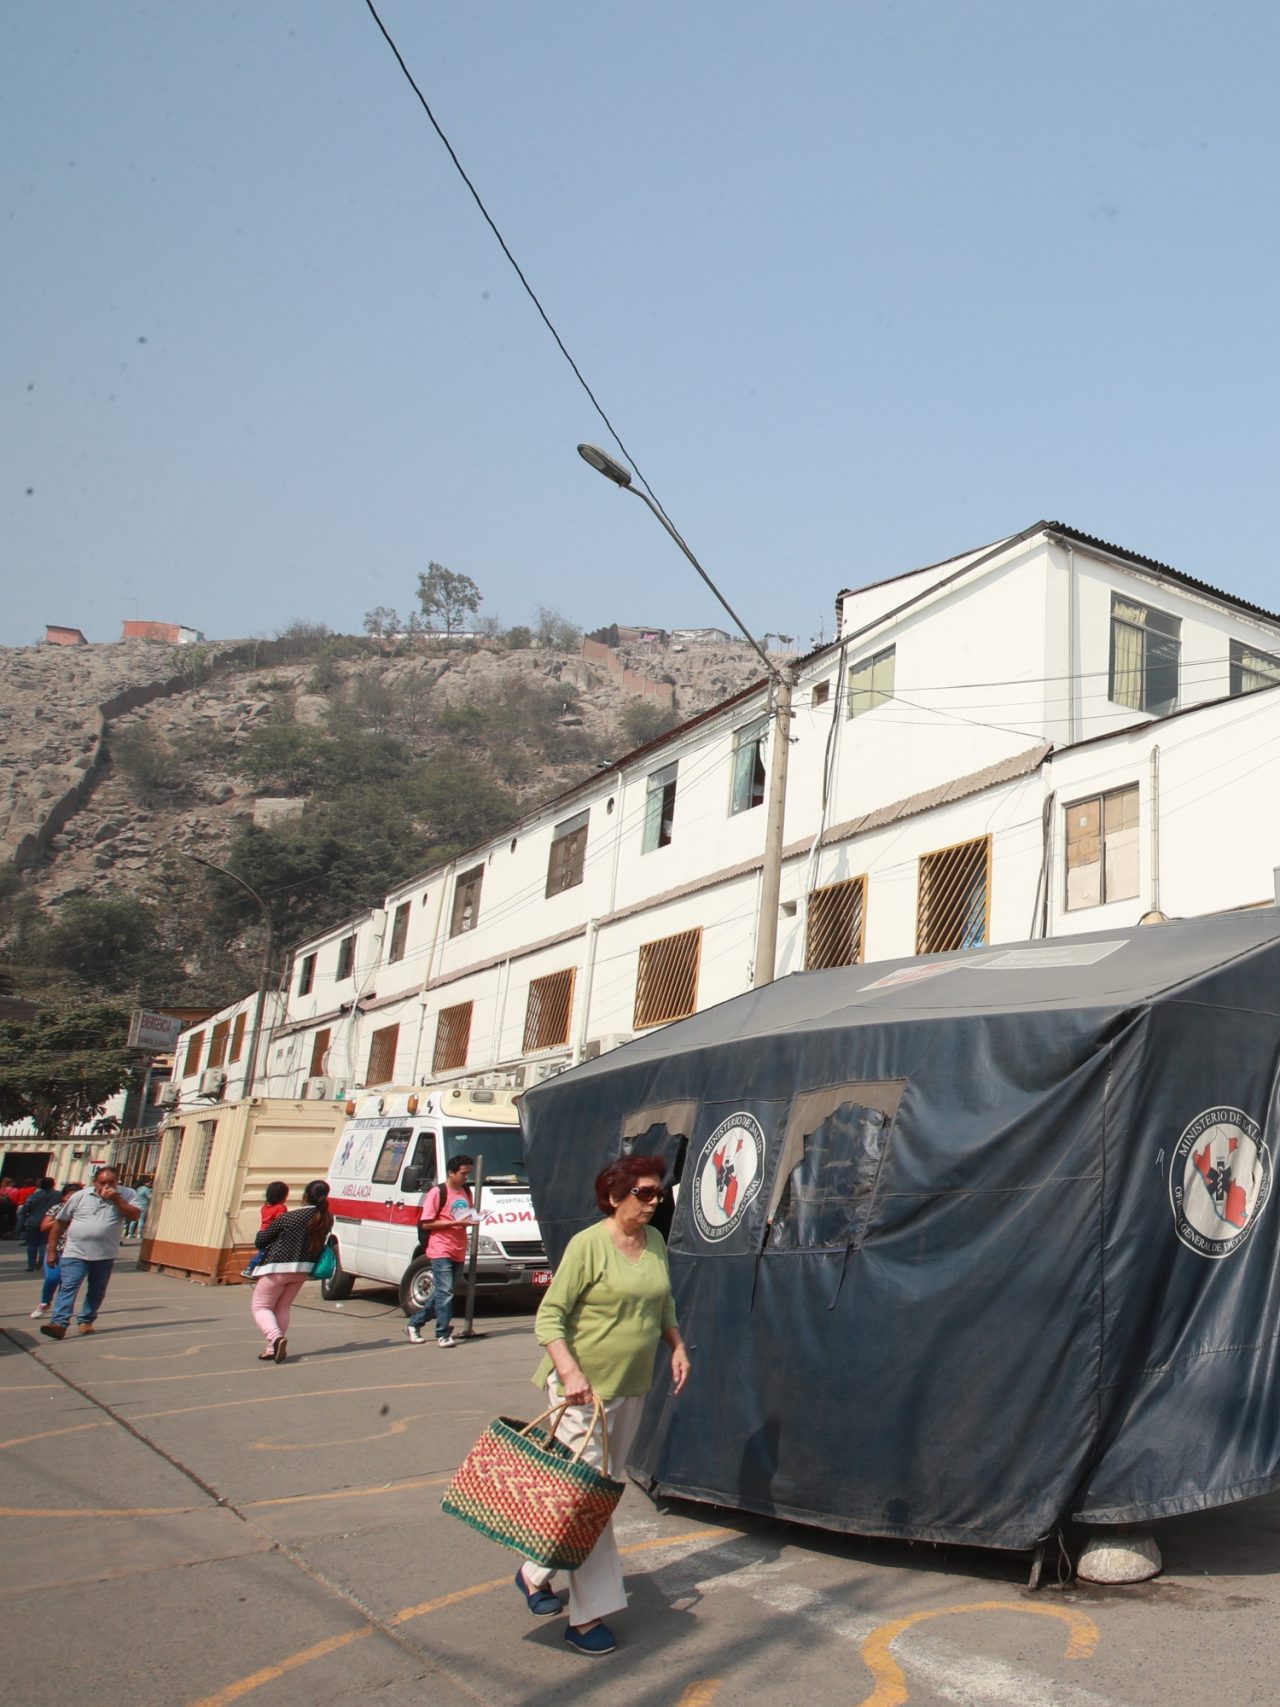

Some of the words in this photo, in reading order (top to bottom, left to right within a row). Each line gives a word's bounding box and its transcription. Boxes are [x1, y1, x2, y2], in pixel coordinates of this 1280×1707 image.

[704, 1116, 743, 1156] MINISTERIO
[1178, 1110, 1228, 1157] MINISTERIO
[1229, 1112, 1242, 1125] DE
[342, 1183, 372, 1198] AMBULANCIA
[1180, 1222, 1211, 1252] GENERAL
